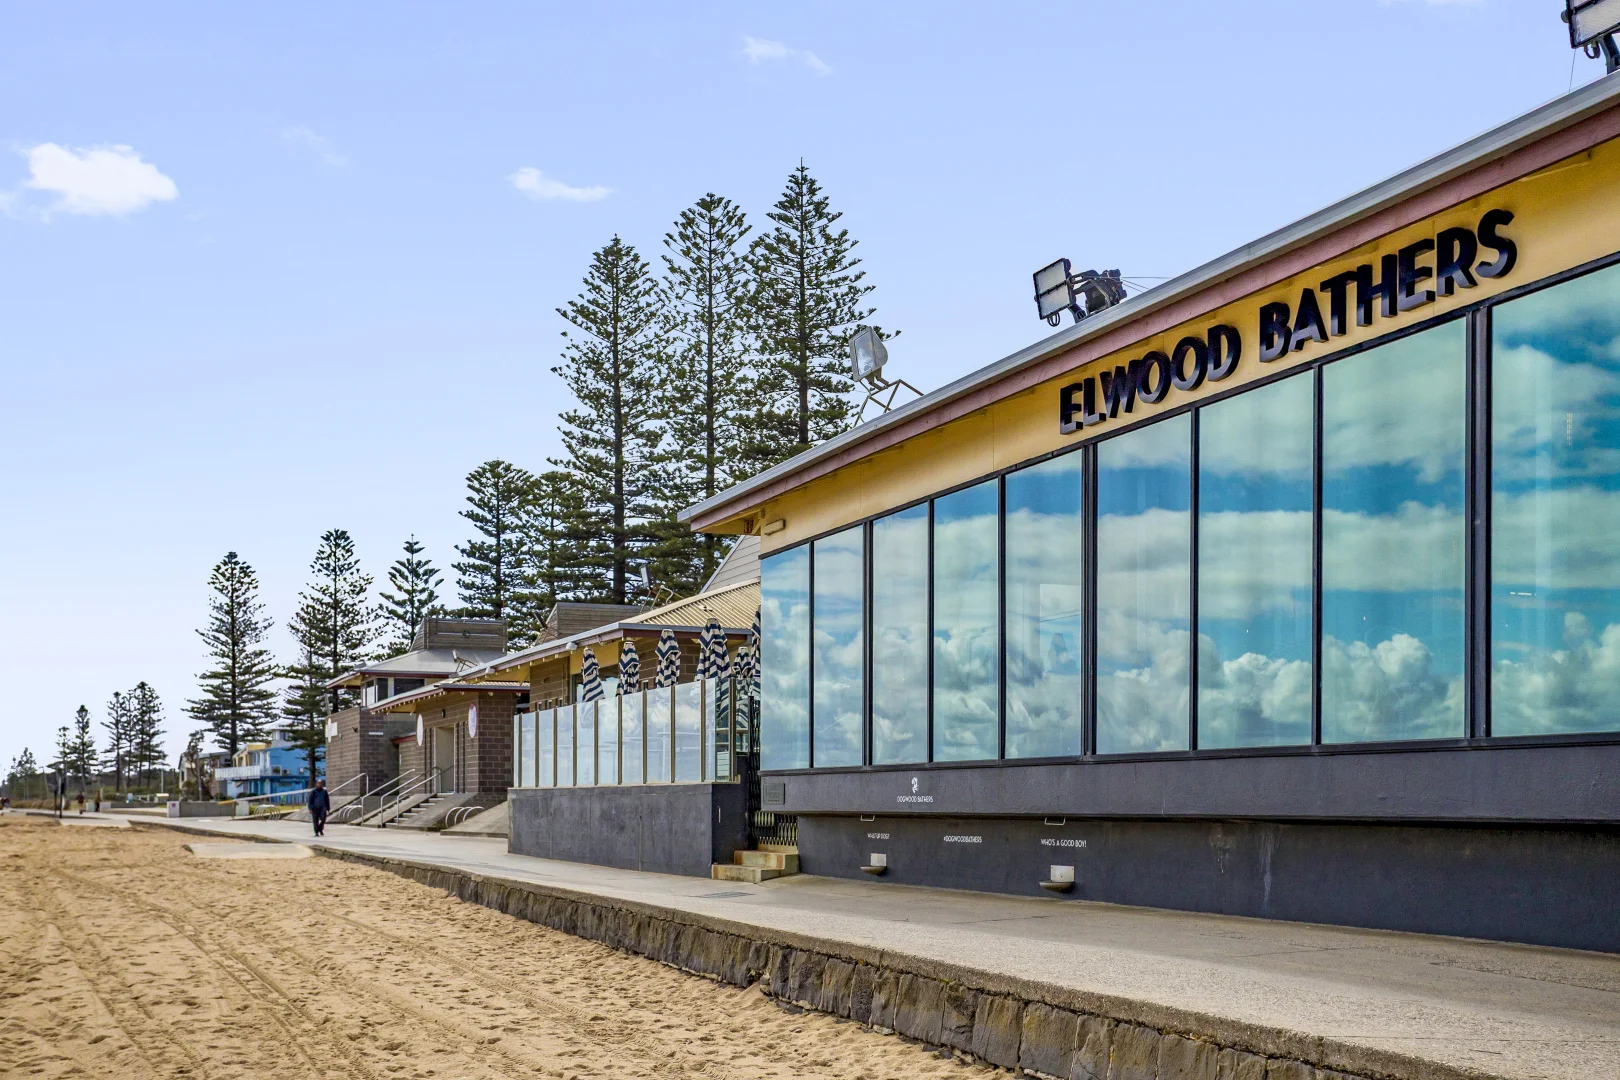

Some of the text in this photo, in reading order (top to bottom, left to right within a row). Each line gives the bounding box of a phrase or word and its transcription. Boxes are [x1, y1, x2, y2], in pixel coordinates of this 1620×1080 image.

[1060, 209, 1518, 435] ELWOOD BATHERS
[1060, 839, 1075, 847] GOOD
[1075, 839, 1087, 848] BOY!
